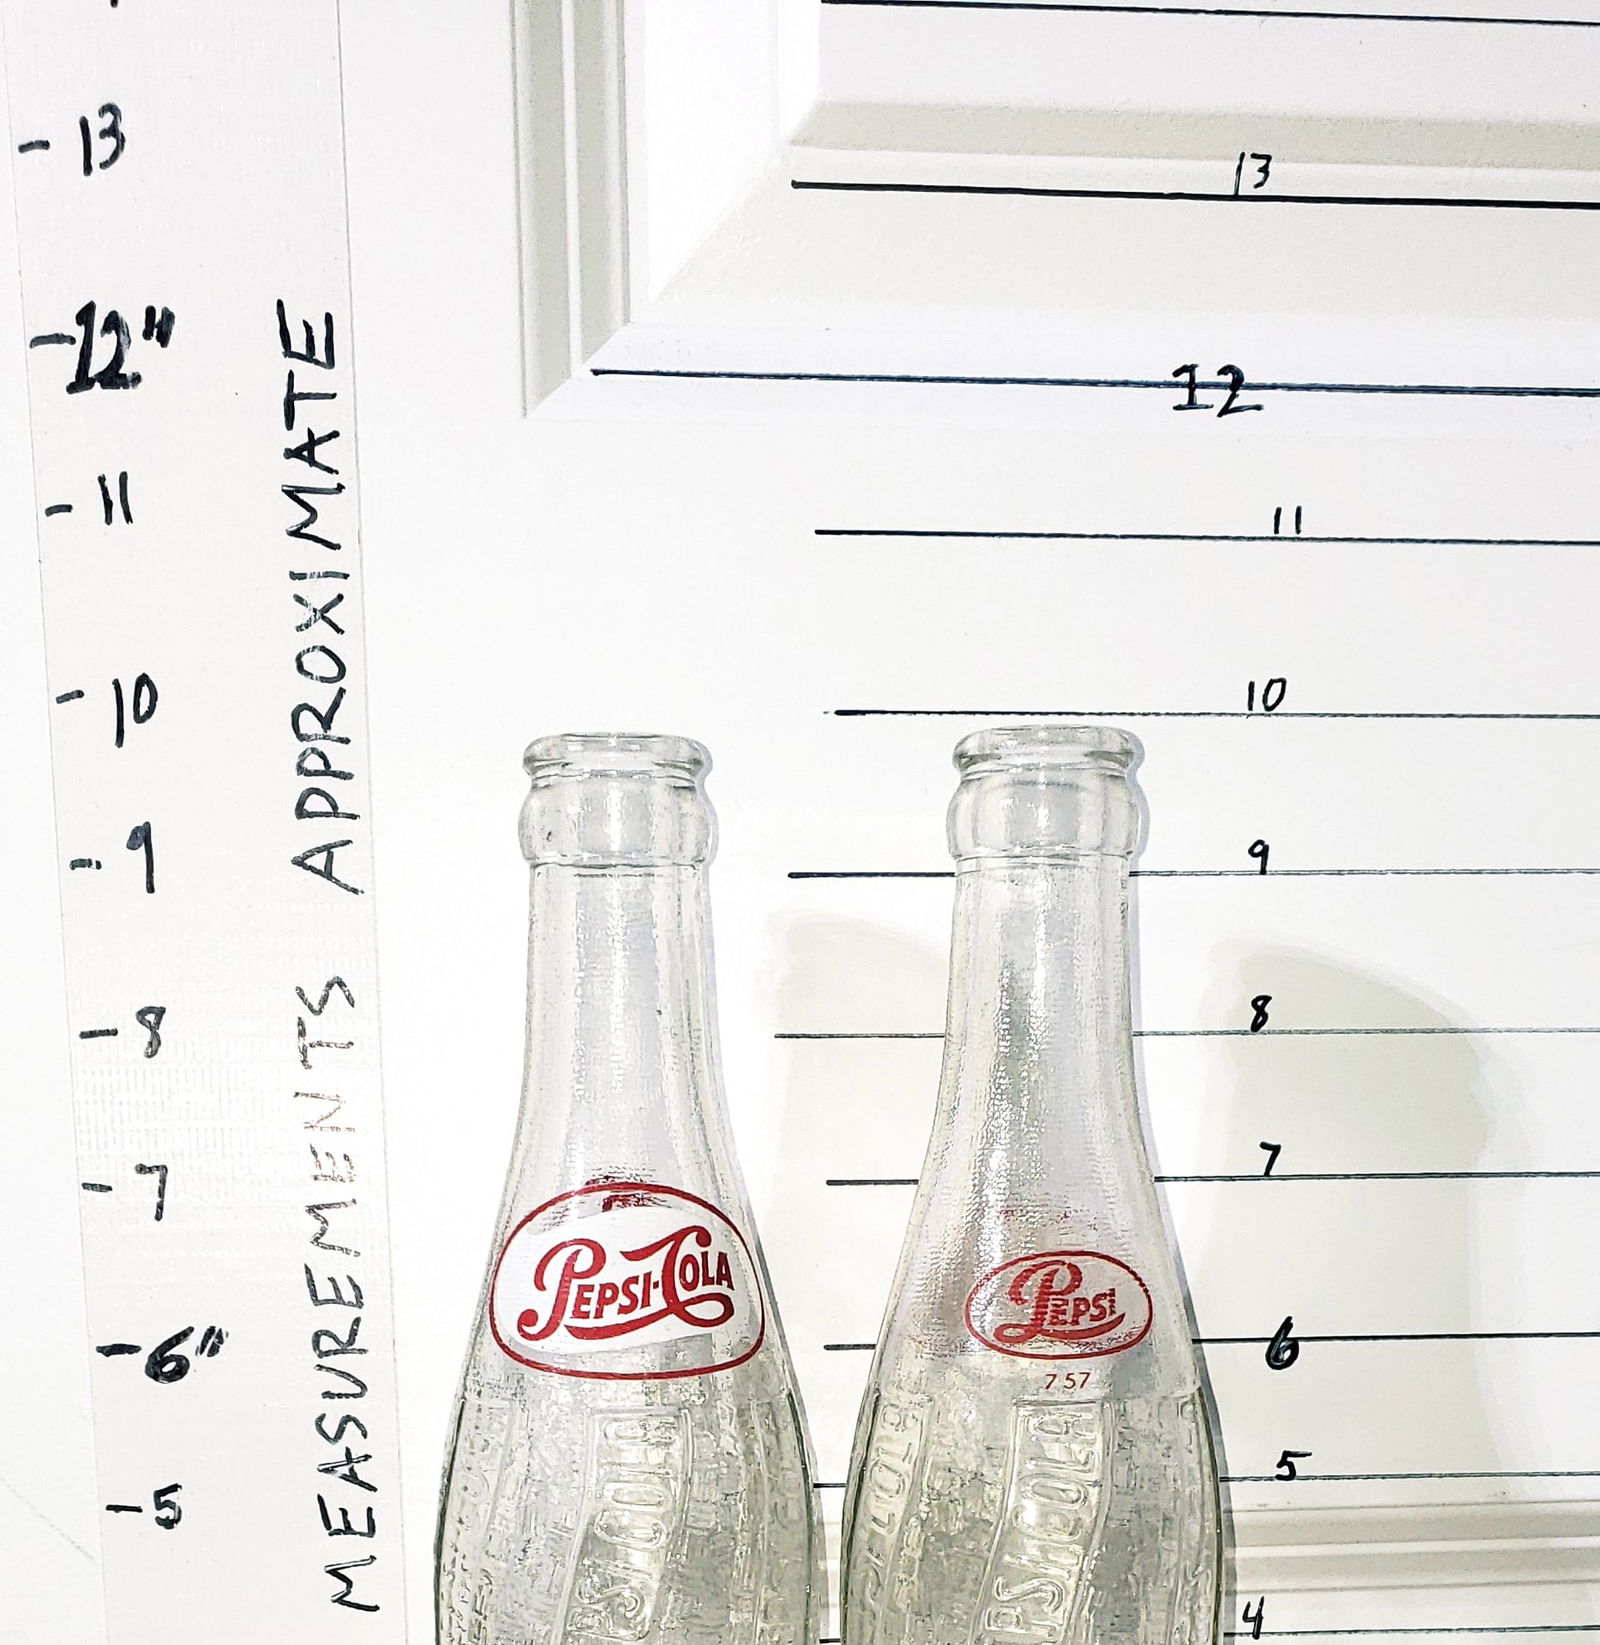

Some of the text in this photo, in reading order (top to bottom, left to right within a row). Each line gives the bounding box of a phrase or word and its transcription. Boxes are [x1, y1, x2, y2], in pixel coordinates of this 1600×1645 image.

[80, 103, 125, 176] 13
[1235, 152, 1272, 197] 13
[1172, 364, 1263, 417] 12
[98, 472, 133, 525] 11
[1274, 506, 1302, 534] 11
[277, 299, 364, 895] APPROXIMATE
[112, 673, 158, 748] 10
[1248, 678, 1287, 711] 10
[127, 822, 155, 893] 9
[1248, 840, 1269, 873] 9
[136, 1006, 166, 1058] 8
[1251, 995, 1272, 1031] 8
[1259, 1142, 1281, 1176] 7
[135, 1164, 168, 1221] 7
[296, 976, 380, 1612] MEASUREMENTS
[518, 1225, 735, 1342] PEPSI-COLA
[994, 1260, 1123, 1342] PEPSI
[1265, 1316, 1299, 1370] 6
[1274, 1450, 1312, 1481] 5
[153, 1483, 182, 1529] 5
[1241, 1596, 1264, 1640] 4
